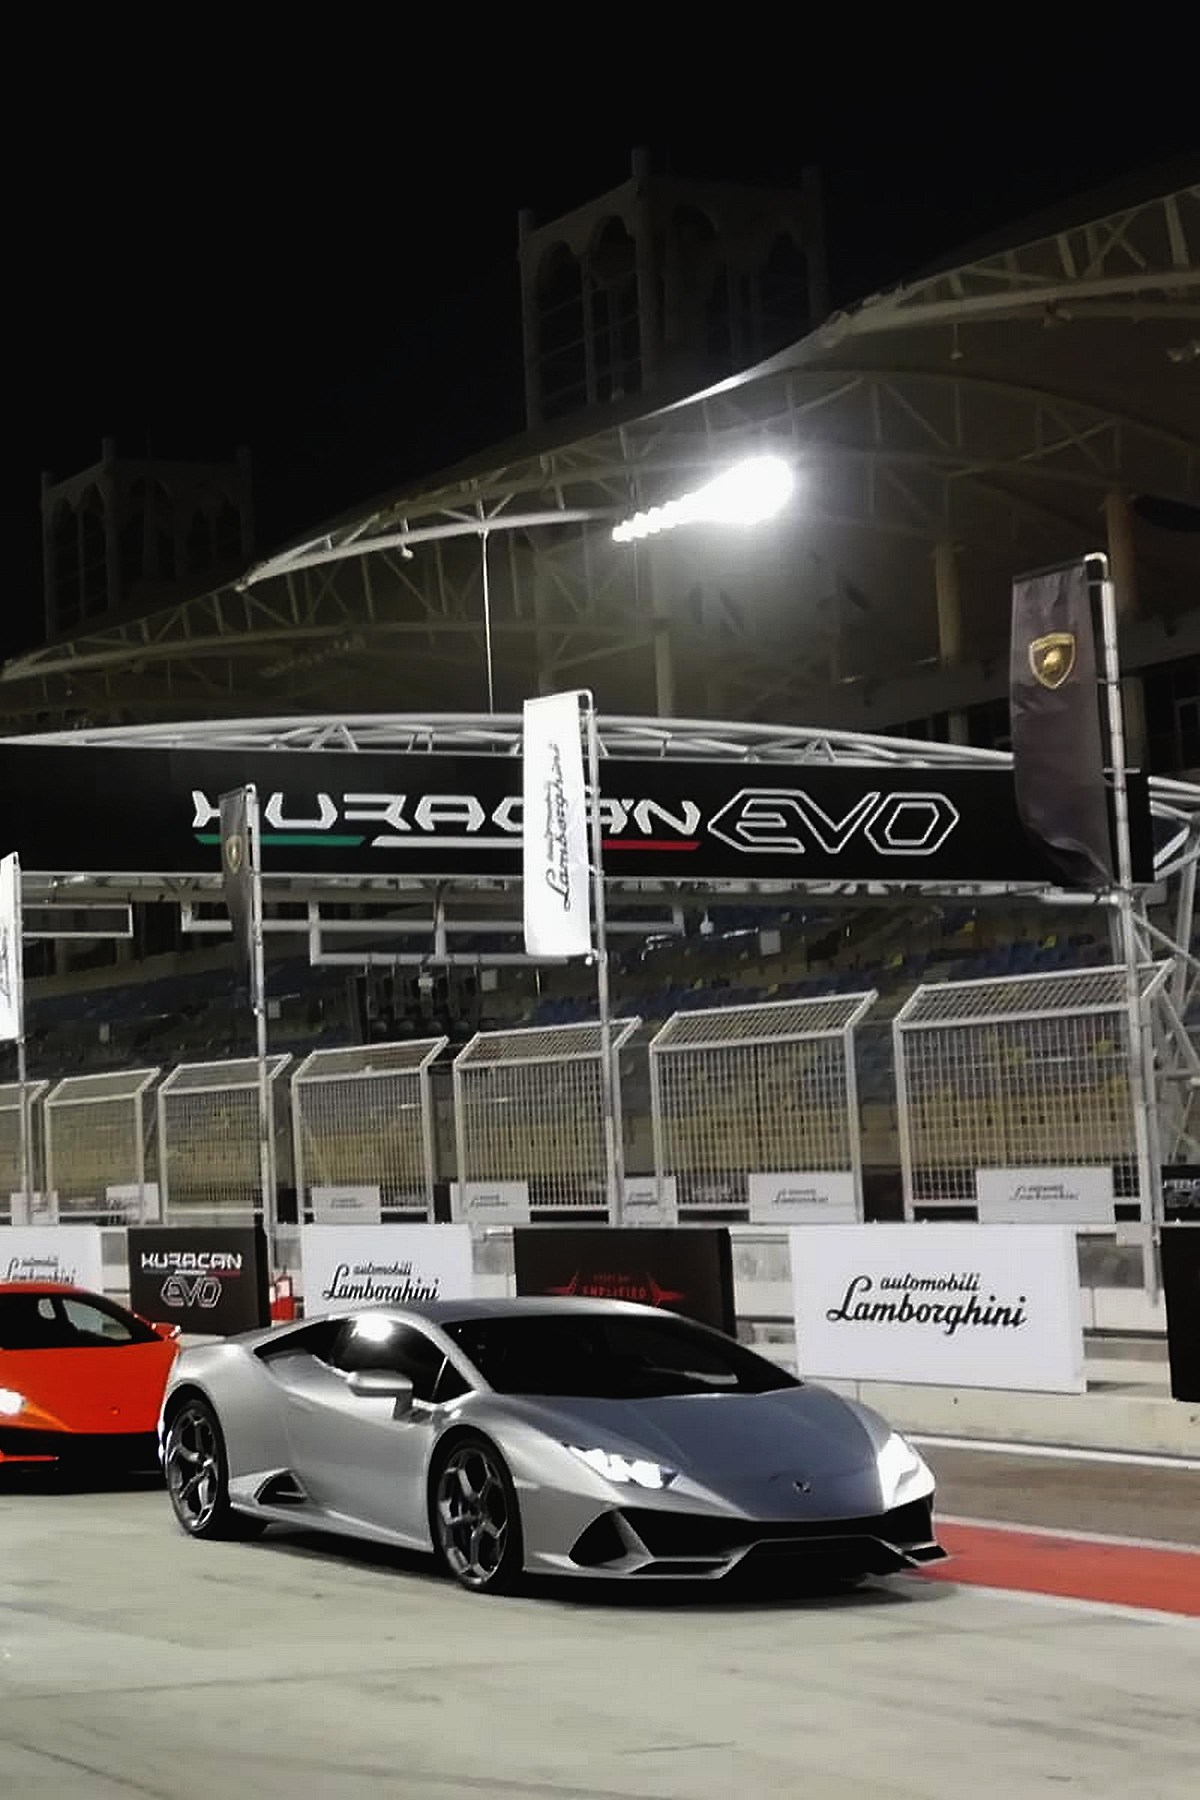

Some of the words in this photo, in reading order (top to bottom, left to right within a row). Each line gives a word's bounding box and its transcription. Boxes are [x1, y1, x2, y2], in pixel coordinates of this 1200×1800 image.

[707, 788, 960, 855] EVO
[161, 1275, 222, 1308] EVO
[322, 1263, 440, 1302] Lamborghini
[880, 1272, 981, 1291] automobili
[826, 1275, 1028, 1336] Lamborghini
